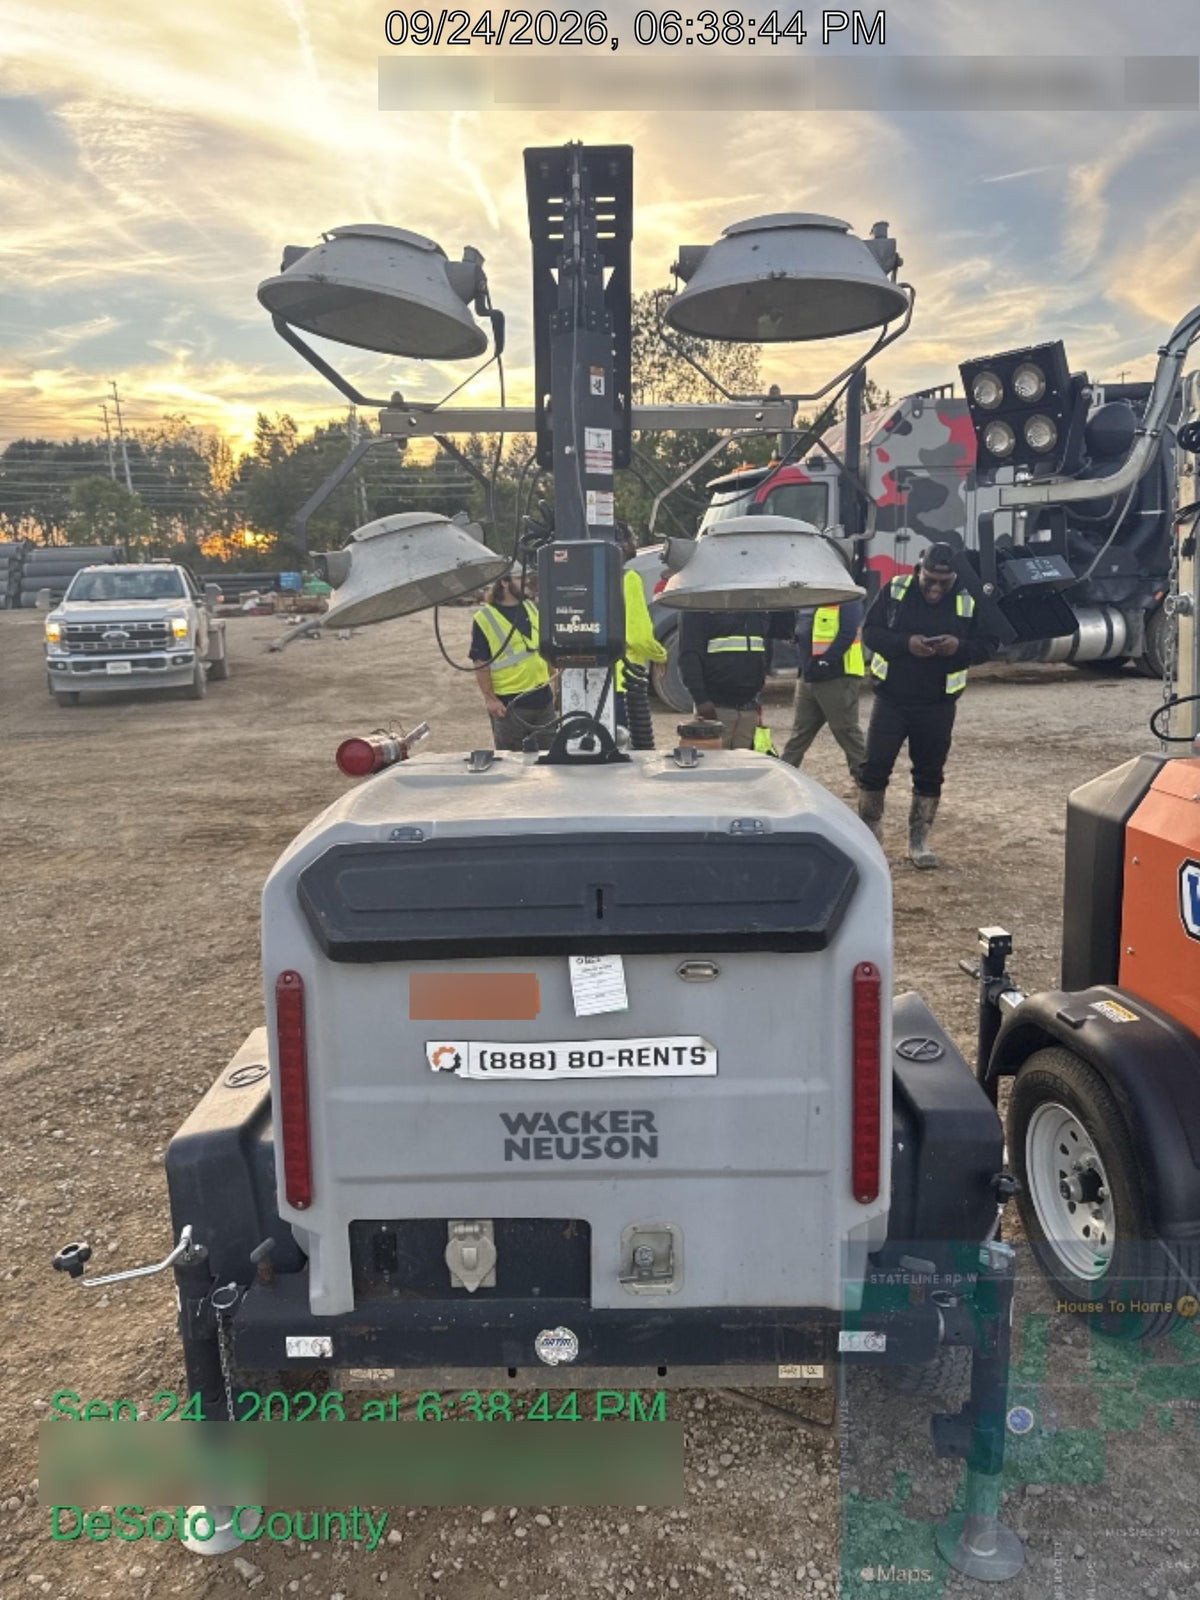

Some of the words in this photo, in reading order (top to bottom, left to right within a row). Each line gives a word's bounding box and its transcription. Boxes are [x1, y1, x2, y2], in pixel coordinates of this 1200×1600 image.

[479, 1050, 557, 1071] (888)
[568, 1046, 708, 1070] 80-RENTS
[499, 1109, 659, 1134] WACKER
[504, 1135, 659, 1161] NEUSON
